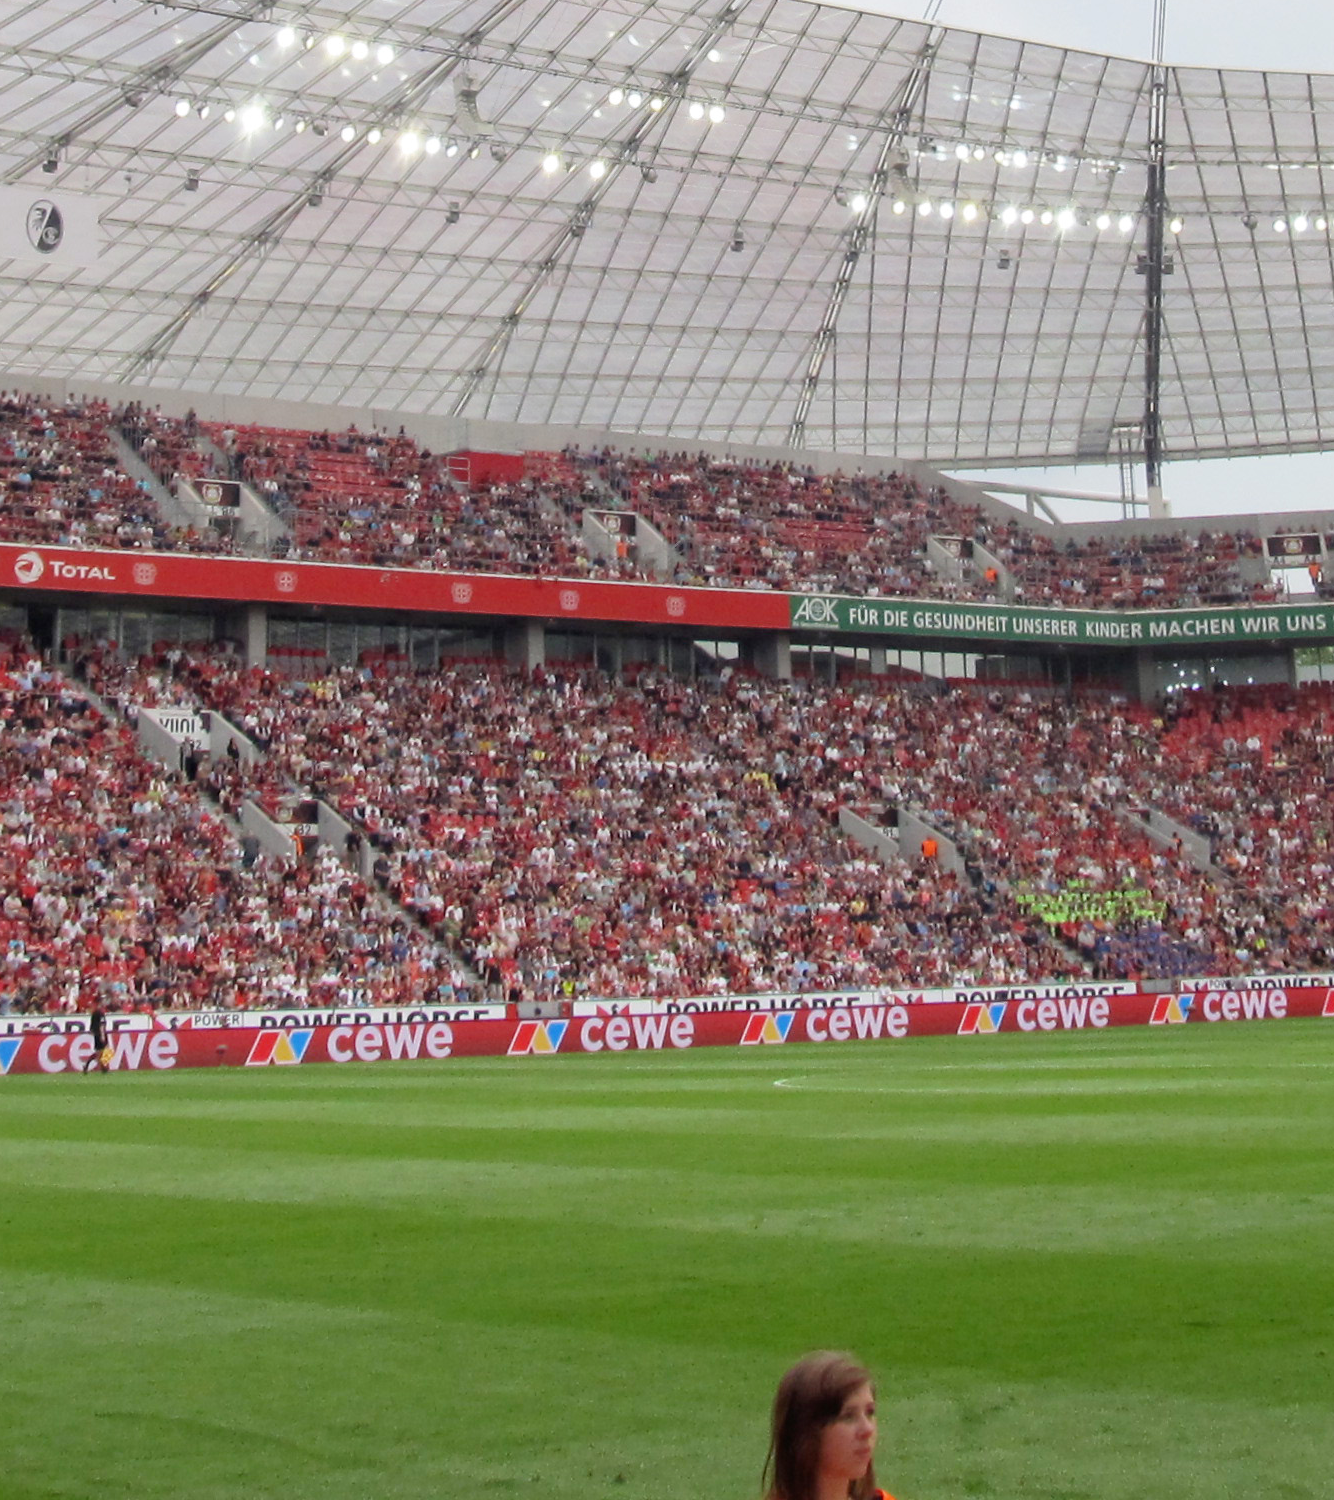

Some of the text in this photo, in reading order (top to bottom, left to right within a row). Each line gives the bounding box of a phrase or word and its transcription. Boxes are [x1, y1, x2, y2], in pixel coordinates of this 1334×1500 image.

[49, 560, 115, 580] TOTAL
[793, 598, 839, 622] AOK
[849, 604, 879, 625] FÜR
[883, 610, 908, 627] DIE
[913, 612, 1008, 633] GESUNDHEIT
[1012, 617, 1078, 636] UNSERER
[1086, 620, 1142, 639] KINDER
[1149, 617, 1236, 638] MACHEN
[1240, 614, 1280, 633] WIR
[1287, 612, 1326, 631] UNS
[1017, 997, 1110, 1031] cewe
[1203, 989, 1288, 1021] cewe
[580, 1015, 694, 1052] cewe
[806, 1005, 909, 1041] cewe
[327, 1022, 454, 1063] cewe
